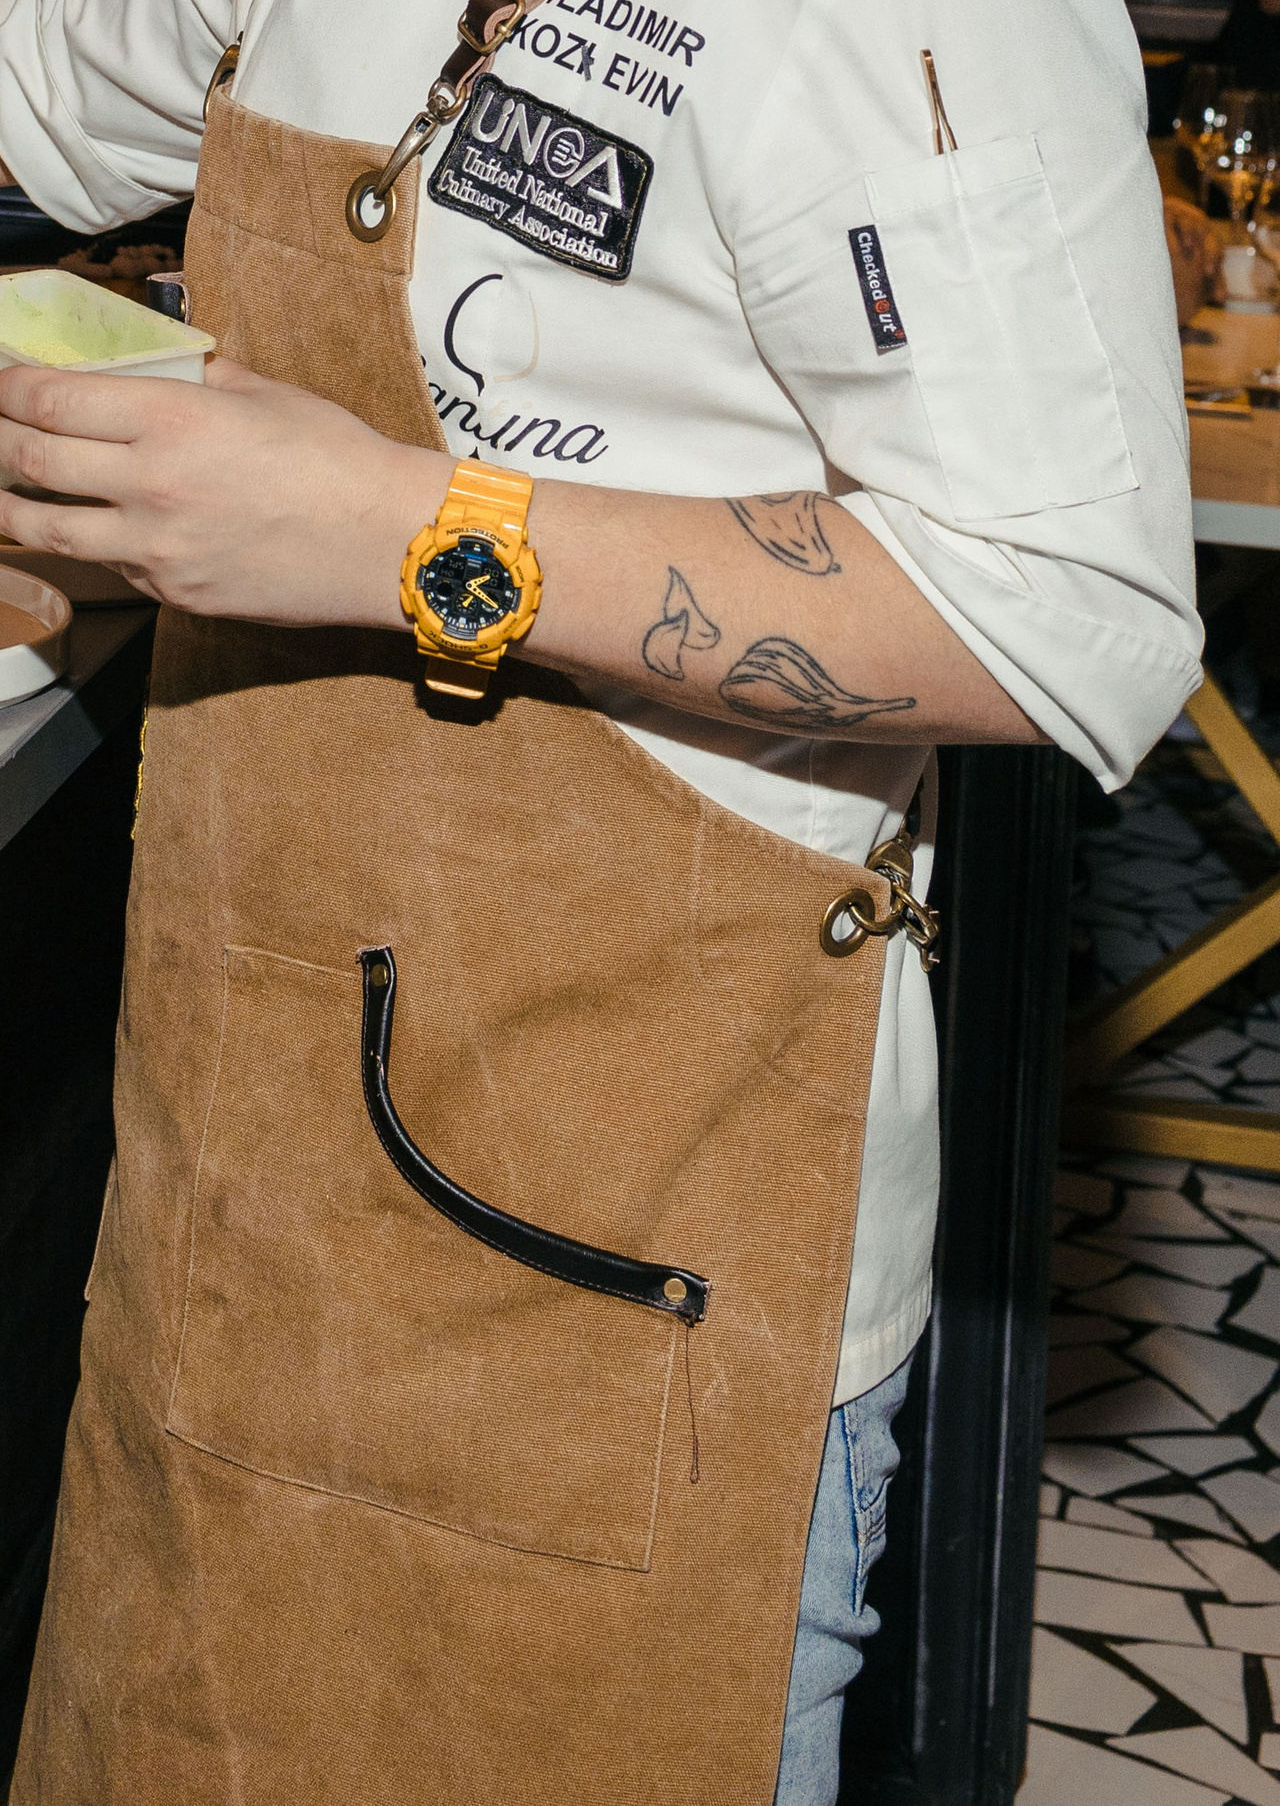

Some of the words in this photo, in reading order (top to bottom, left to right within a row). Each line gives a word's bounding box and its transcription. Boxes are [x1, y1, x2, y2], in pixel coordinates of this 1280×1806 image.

[438, 169, 510, 218] Culinary
[508, 205, 619, 269] Association
[461, 146, 523, 196] United
[520, 175, 609, 238] National
[446, 527, 510, 549] PROTECTION
[428, 630, 489, 652] G-SHOCK
